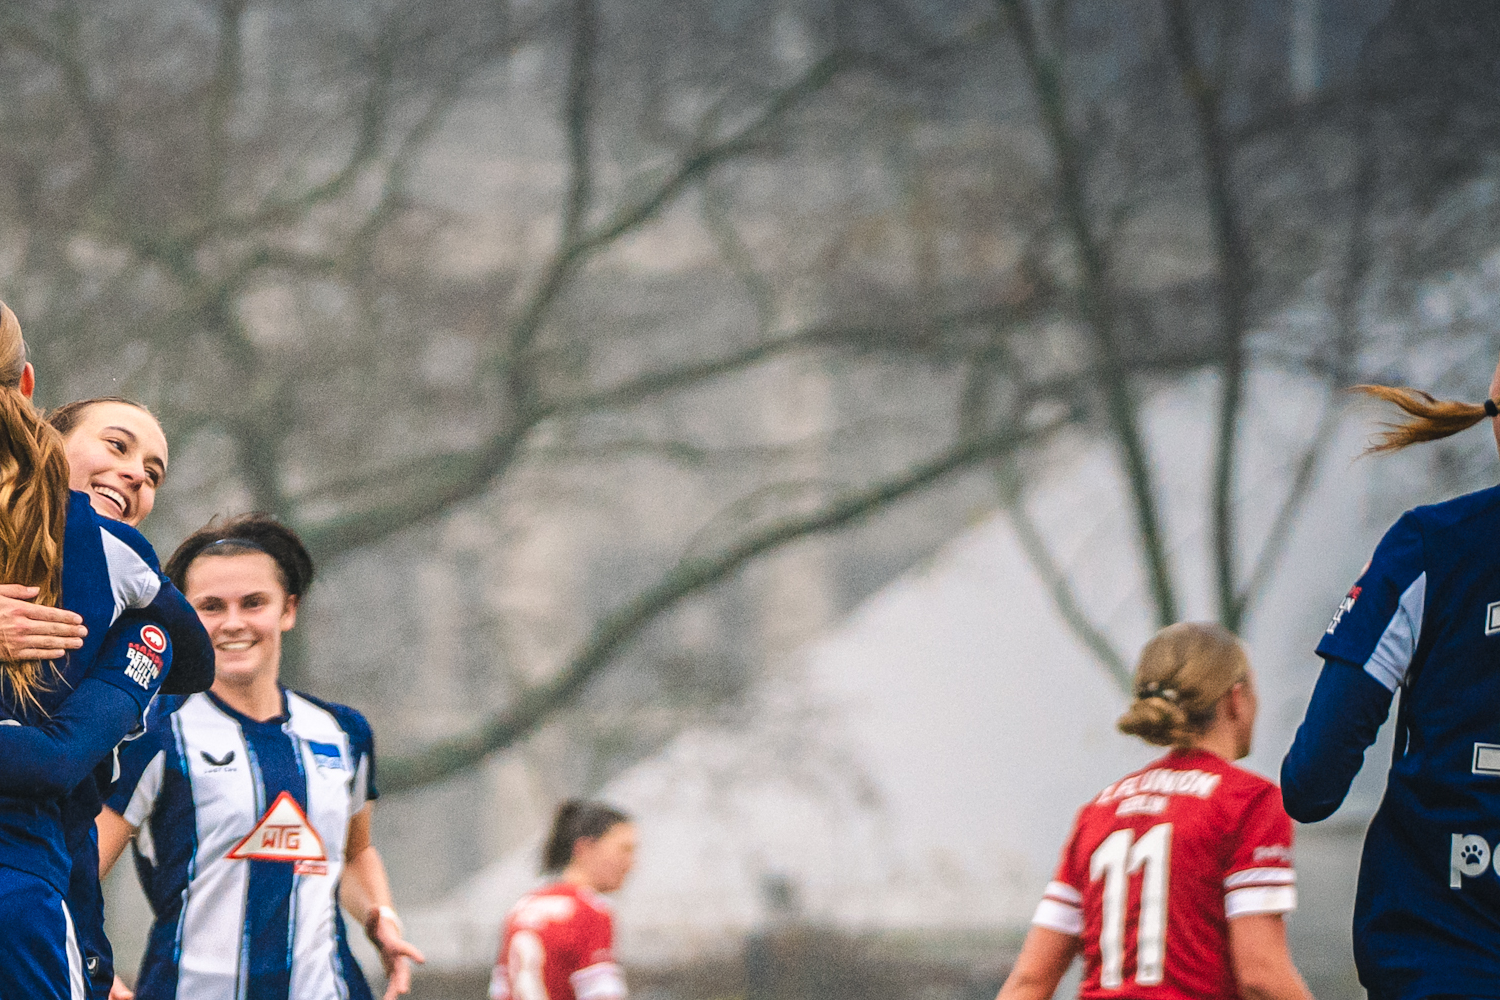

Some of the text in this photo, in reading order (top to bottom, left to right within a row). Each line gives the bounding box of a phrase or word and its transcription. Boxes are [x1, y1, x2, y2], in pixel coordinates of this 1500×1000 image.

[126, 647, 160, 680] BERLIN
[129, 658, 152, 684] NULL
[123, 664, 149, 691] NULL
[261, 825, 302, 849] WTG
[1089, 821, 1174, 990] 11
